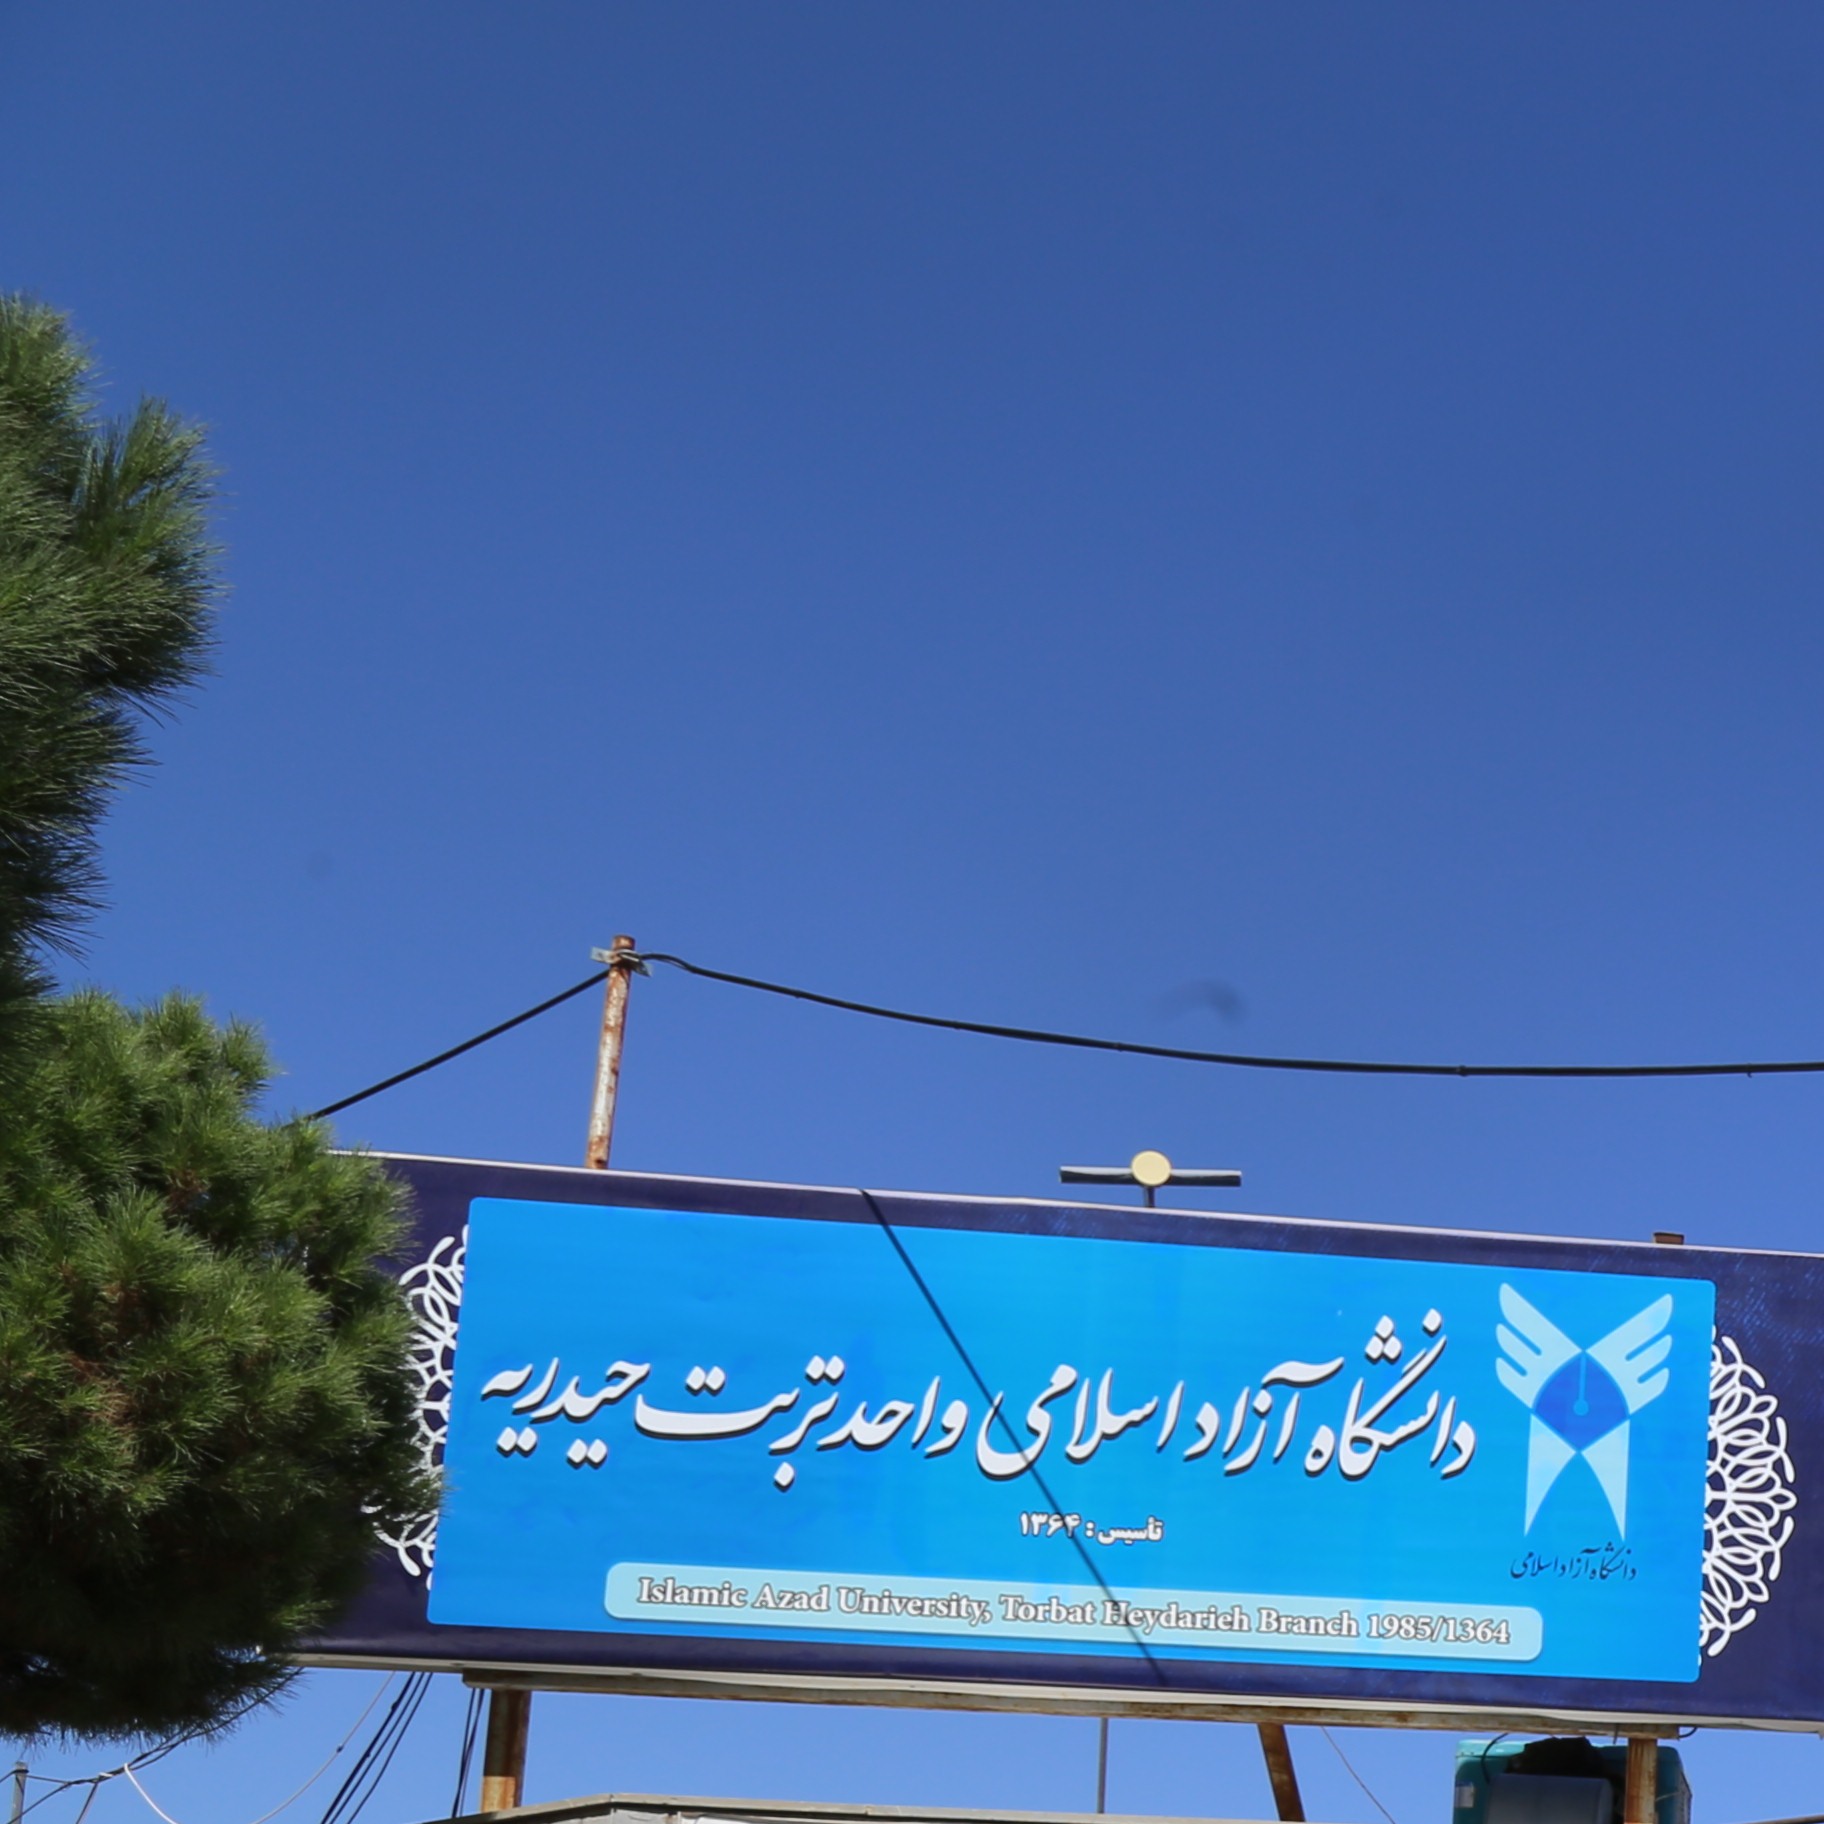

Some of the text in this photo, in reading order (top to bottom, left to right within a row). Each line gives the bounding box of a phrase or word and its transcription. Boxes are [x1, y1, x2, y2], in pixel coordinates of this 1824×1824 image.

[480, 1307, 1477, 1491] دانشگاه آزاد اسلامی واحد تربت حیدریه
[1510, 1551, 1559, 1580] اسلامی
[1588, 1542, 1638, 1583] دانشگاه
[638, 1577, 1509, 1644] Islamic Azad University, Torbat Heydarieh Branch 1985/1364
